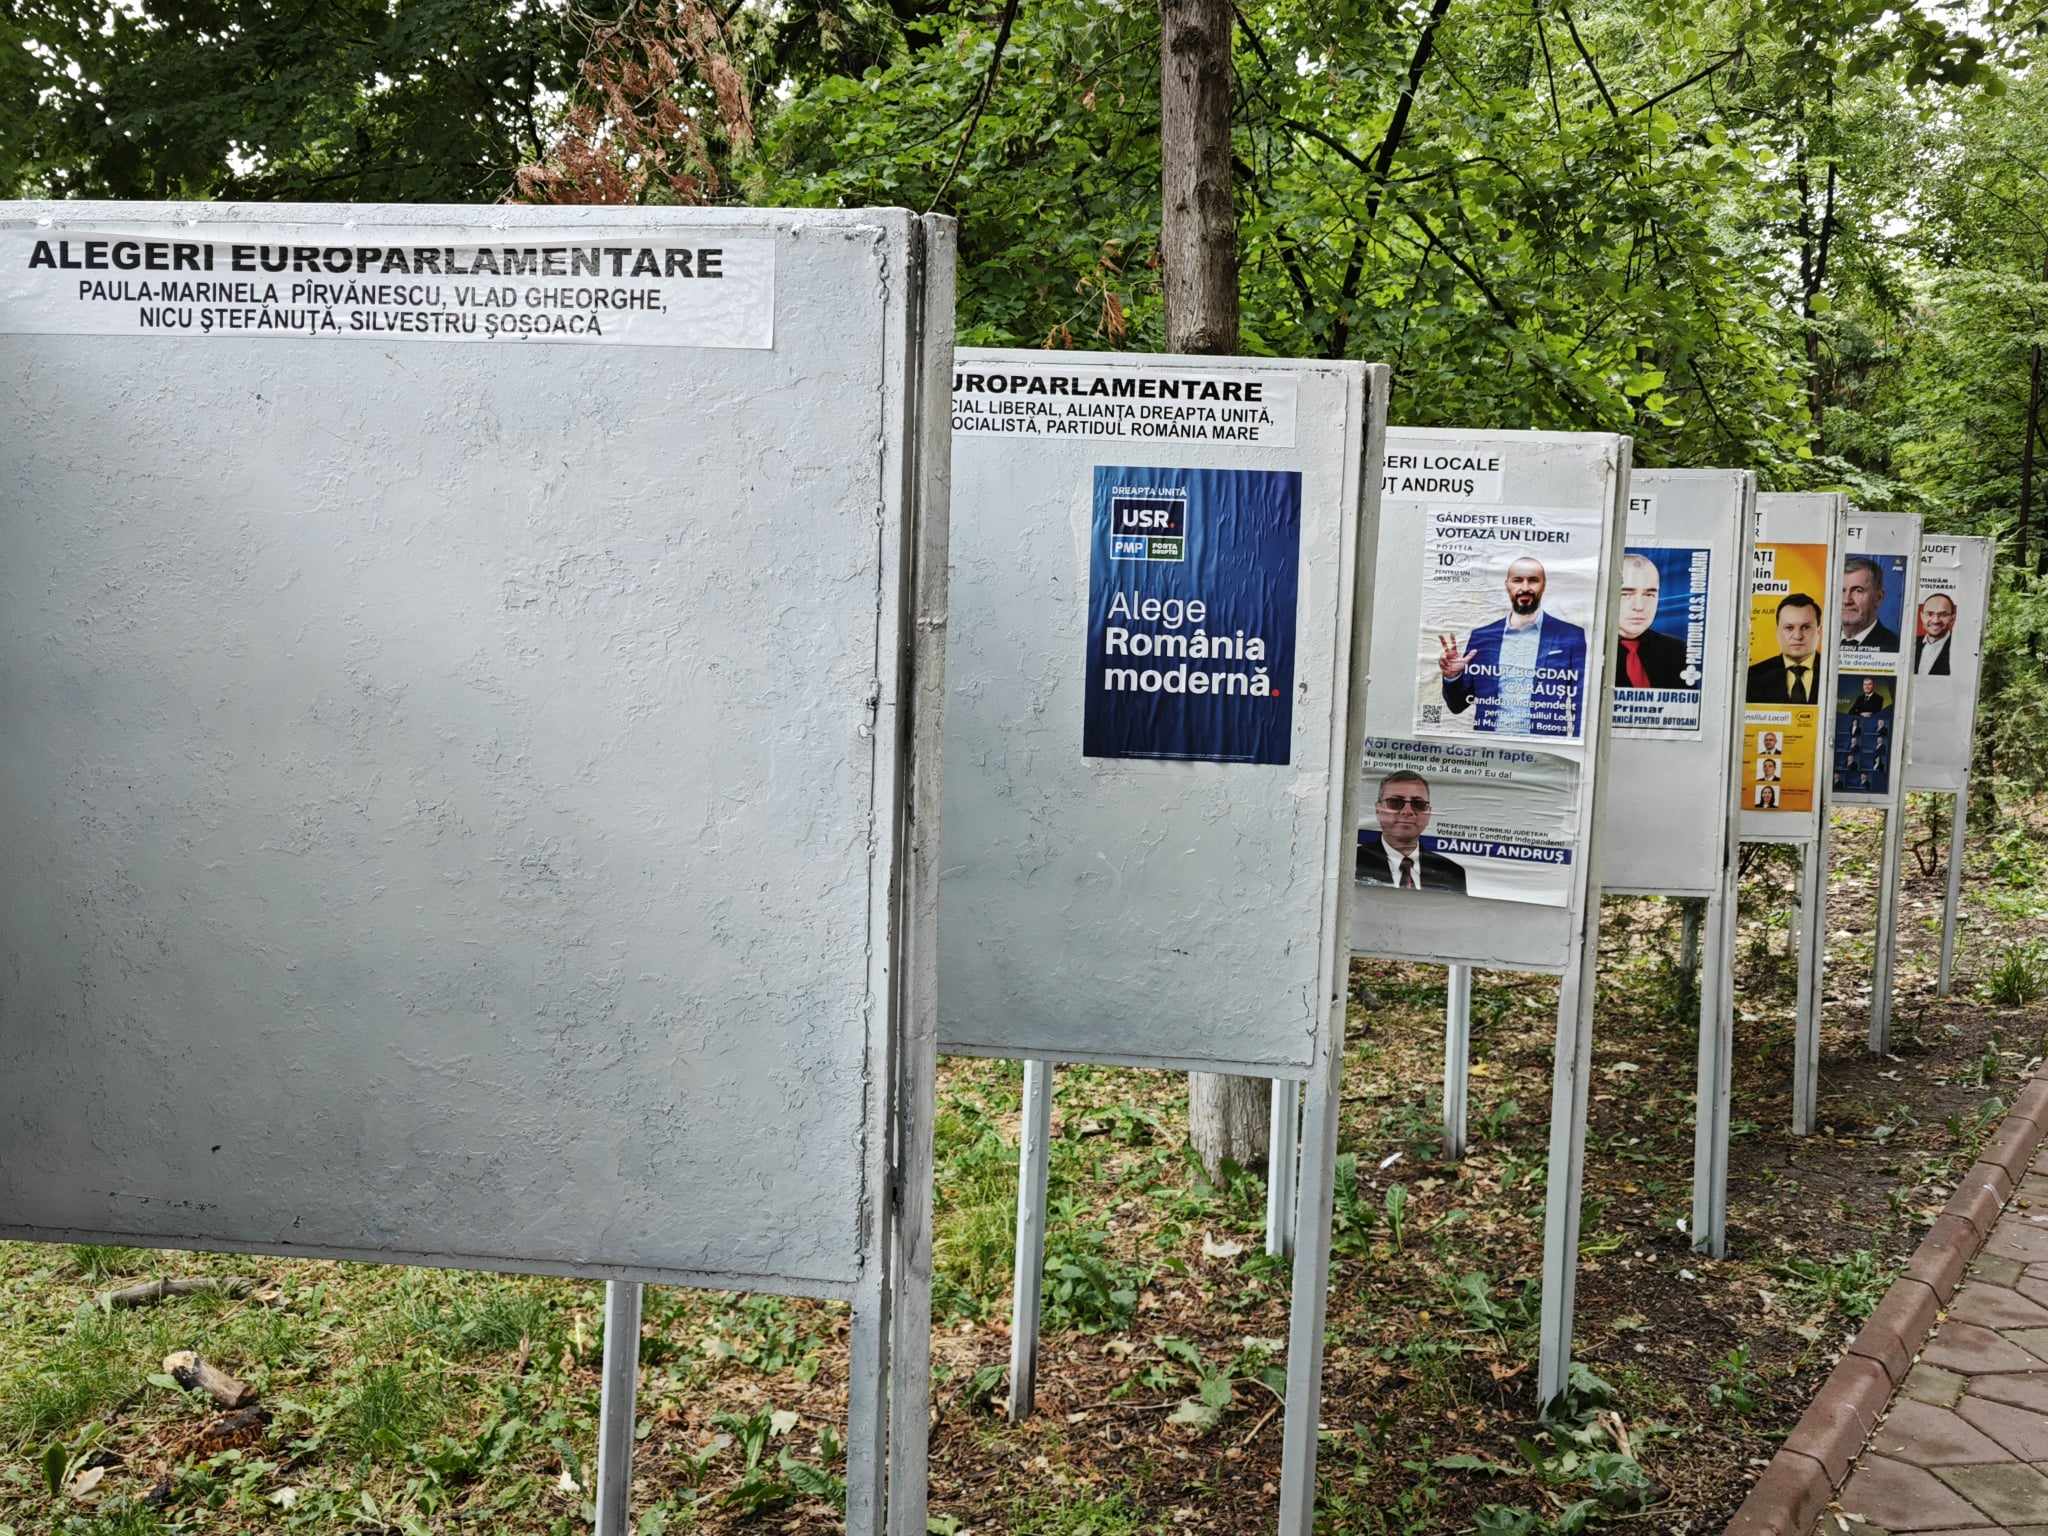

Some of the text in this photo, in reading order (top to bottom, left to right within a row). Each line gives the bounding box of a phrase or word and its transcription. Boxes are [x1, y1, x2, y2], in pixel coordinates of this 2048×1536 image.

[28, 240, 723, 279] ALEGERI EUROPARLAMENTARE
[79, 279, 667, 314] PAULA-MARINELA PÎRVĂNESCU, VLAD GHEORGHE,
[140, 307, 192, 328] NICU
[350, 311, 476, 333] SILVESTRU
[989, 401, 1062, 417] LIBERAL,
[1140, 405, 1216, 421] DREAPTA
[1221, 407, 1274, 426] UNITĂ,
[1047, 420, 1126, 435] PARTIDUL
[1131, 421, 1211, 439] ROMÂNIA
[1212, 426, 1259, 440] MARE
[1423, 456, 1500, 471] LOCALE
[1112, 486, 1156, 496] DREAPTA
[1501, 516, 1536, 527] LIBER,
[1436, 527, 1570, 543] VOTEAZĂ UN LIDER!
[1115, 541, 1143, 553] PMP
[1438, 553, 1455, 567] 10
[1107, 590, 1207, 630] Alege
[1104, 626, 1265, 661] România
[1104, 663, 1281, 697] modernă.
[1516, 666, 1579, 681] BOGDAN
[1657, 691, 1699, 704] JURGIU
[1613, 703, 1664, 713] Primar
[1364, 736, 1537, 764] Noi credem doar în fapte.
[1429, 755, 1440, 763] de
[1405, 762, 1424, 771] timp
[1426, 764, 1438, 772] de
[1451, 766, 1462, 774] de
[1463, 768, 1482, 776] ani?
[1484, 769, 1496, 778] Eu
[1498, 771, 1512, 779] da!
